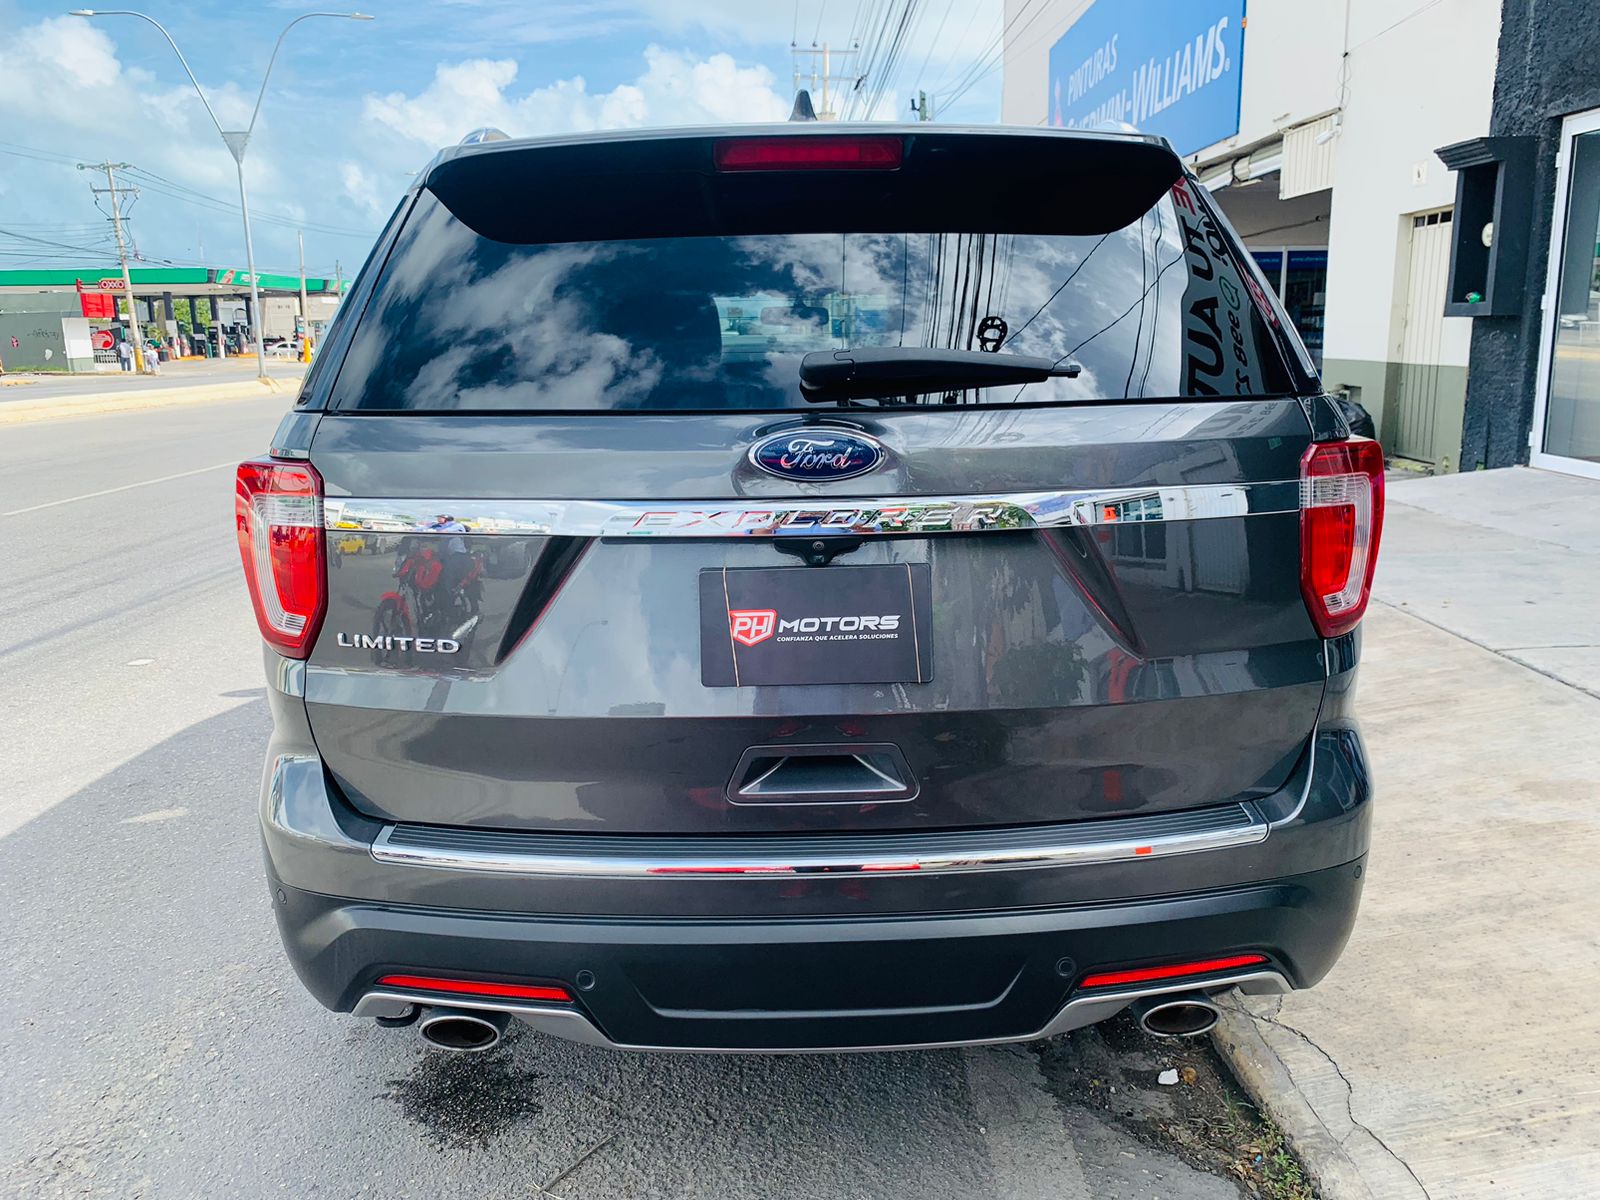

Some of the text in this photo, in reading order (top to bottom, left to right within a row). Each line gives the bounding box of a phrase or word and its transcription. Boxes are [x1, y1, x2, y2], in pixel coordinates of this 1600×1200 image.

[1067, 33, 1118, 106] PINTURAS
[1067, 16, 1229, 128] IN-WILLIAMS
[101, 280, 125, 289] OXXO
[780, 439, 852, 469] Ford
[632, 504, 1004, 529] EXPLORER
[778, 615, 901, 633] MOTORS
[337, 632, 460, 654] LIMITED
